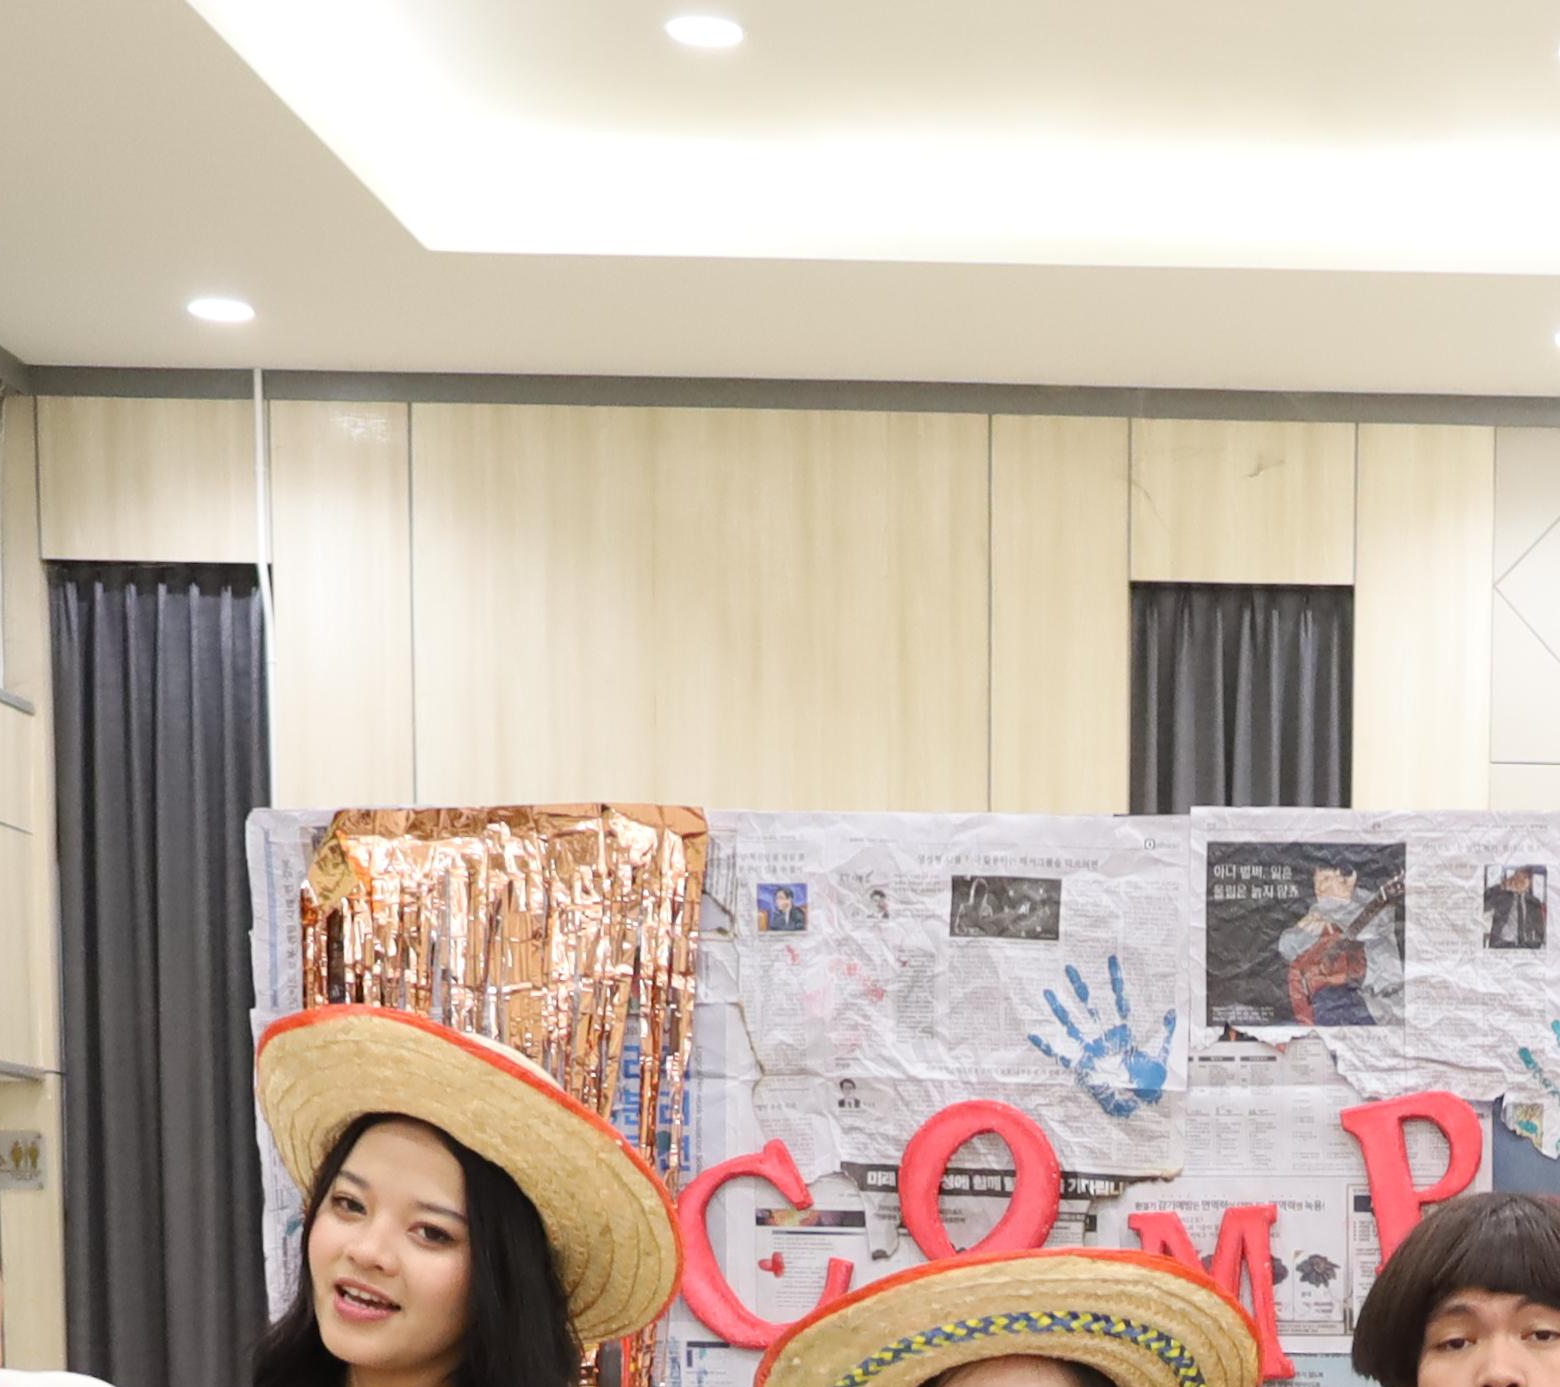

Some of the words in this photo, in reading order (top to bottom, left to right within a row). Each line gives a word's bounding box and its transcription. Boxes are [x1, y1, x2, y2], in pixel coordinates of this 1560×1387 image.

[1213, 864, 1236, 880] 아니
[866, 1171, 897, 1187] 미래
[940, 1173, 970, 1190] 성에
[973, 1174, 1002, 1191] 함께
